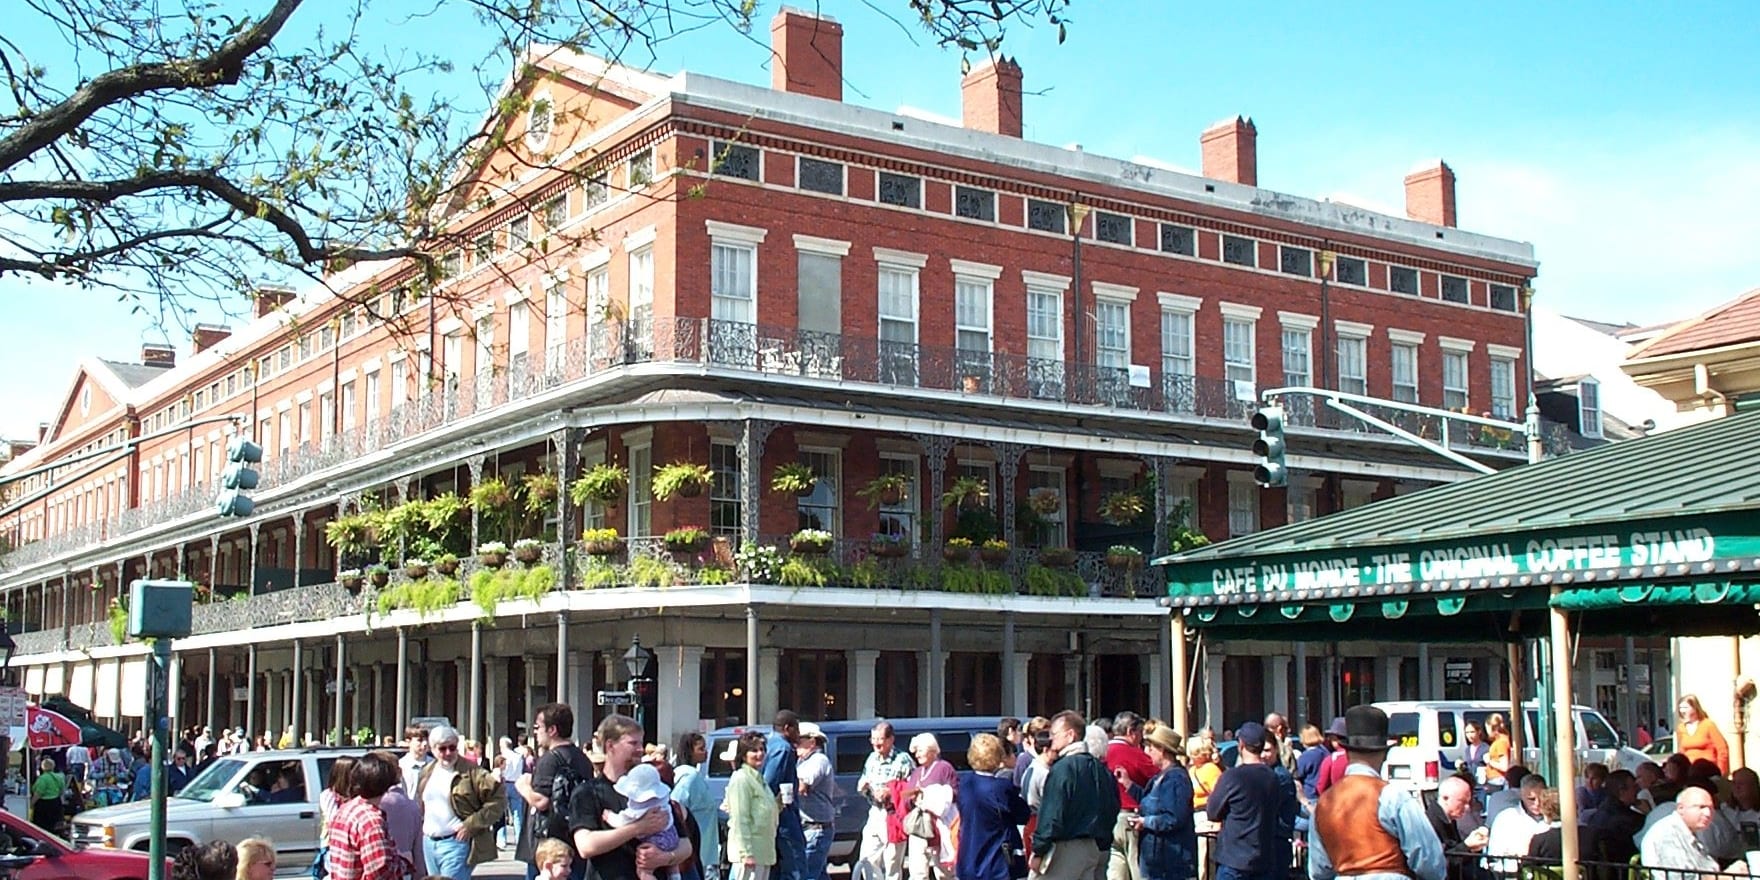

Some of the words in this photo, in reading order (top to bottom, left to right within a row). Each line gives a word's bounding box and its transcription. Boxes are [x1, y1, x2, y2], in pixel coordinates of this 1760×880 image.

[1212, 560, 1257, 595] CAFÉ
[1262, 563, 1288, 591] DU
[1293, 557, 1360, 590] MONDE
[1372, 552, 1413, 584] THE
[1419, 543, 1519, 580] ORIGINAL
[1526, 535, 1620, 573] COFFEE
[1630, 528, 1715, 566] STAND
